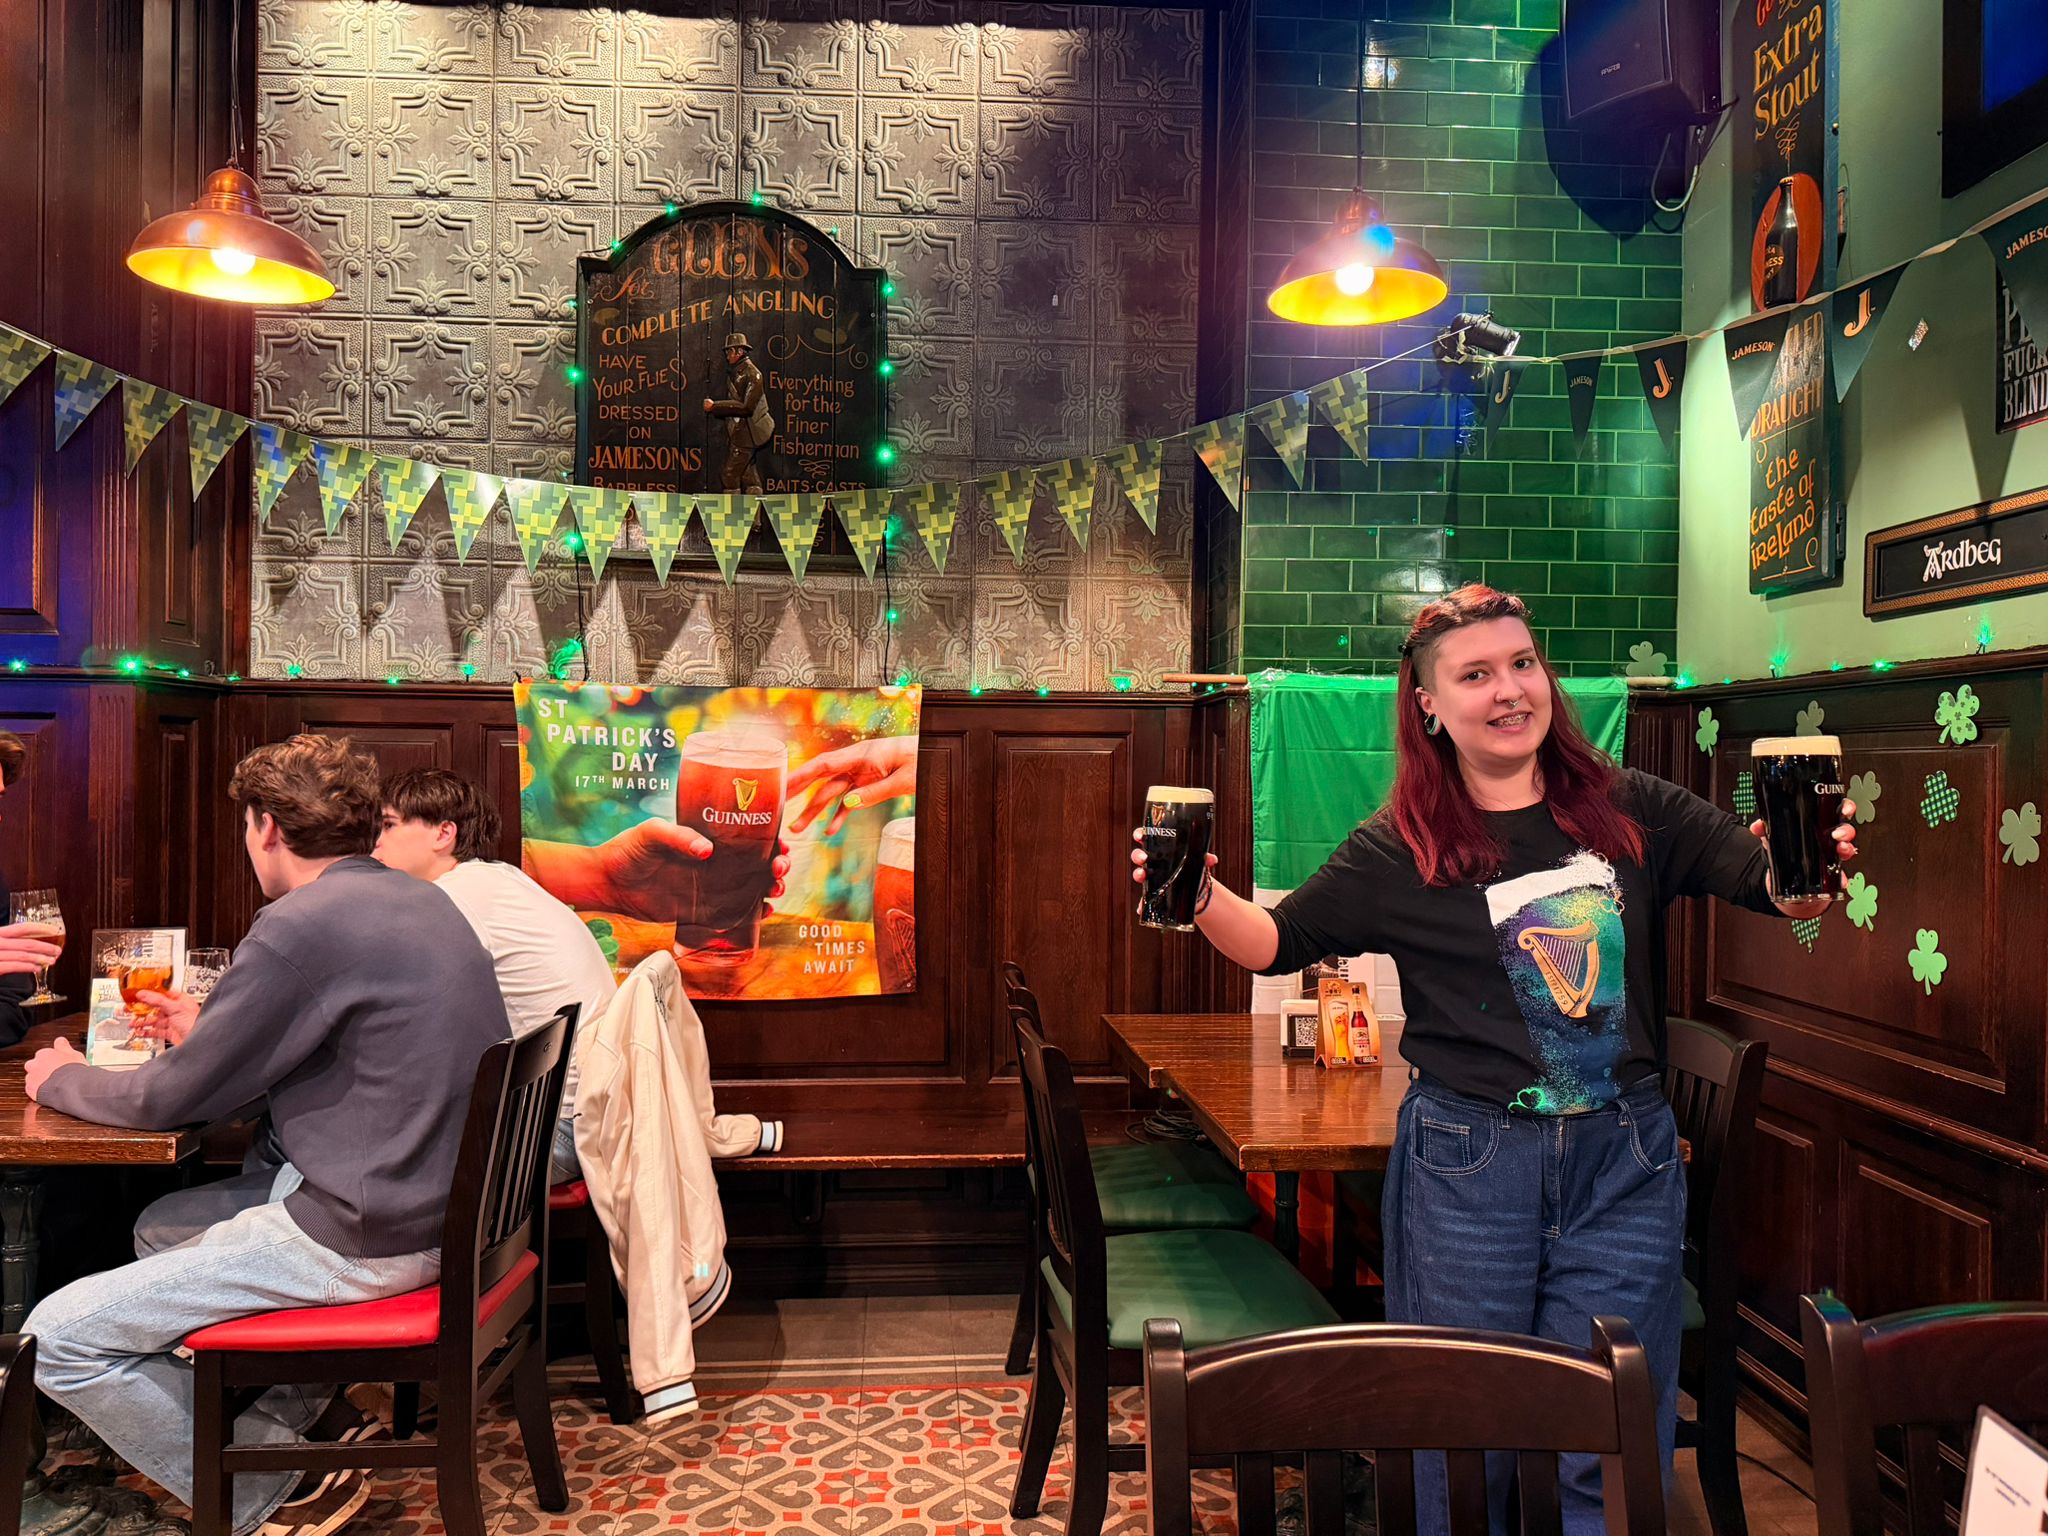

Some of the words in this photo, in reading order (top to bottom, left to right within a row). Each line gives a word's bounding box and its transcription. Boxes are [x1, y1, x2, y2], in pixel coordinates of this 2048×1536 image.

[1753, 4, 1823, 94] Extra
[1755, 47, 1821, 142] Stout
[601, 299, 713, 346] COMPLETE
[722, 290, 838, 320] ANGLING
[1731, 341, 1775, 360] JAMESON
[599, 354, 647, 369] HAVE
[592, 376, 636, 400] YOUR
[639, 358, 688, 391] FLIES
[769, 371, 855, 398] Everything
[599, 405, 680, 421] DRESSED
[785, 392, 810, 412] for
[813, 395, 841, 414] the
[628, 426, 652, 439] ON
[786, 414, 830, 434] Finer
[773, 435, 860, 459] Fisherman
[588, 445, 703, 471] JAMESONS
[1765, 448, 1800, 490] the
[1750, 484, 1796, 536] taste
[1799, 458, 1817, 498] of
[538, 698, 569, 719] ST
[547, 724, 677, 748] PATRICK'S
[612, 751, 659, 772] DAY
[575, 775, 605, 788] 17TH
[612, 776, 670, 791] MARCH
[702, 807, 772, 826] GUINNESS
[799, 925, 843, 938] GOOD
[815, 941, 866, 956] TIMES
[803, 960, 855, 974] AWAIT
